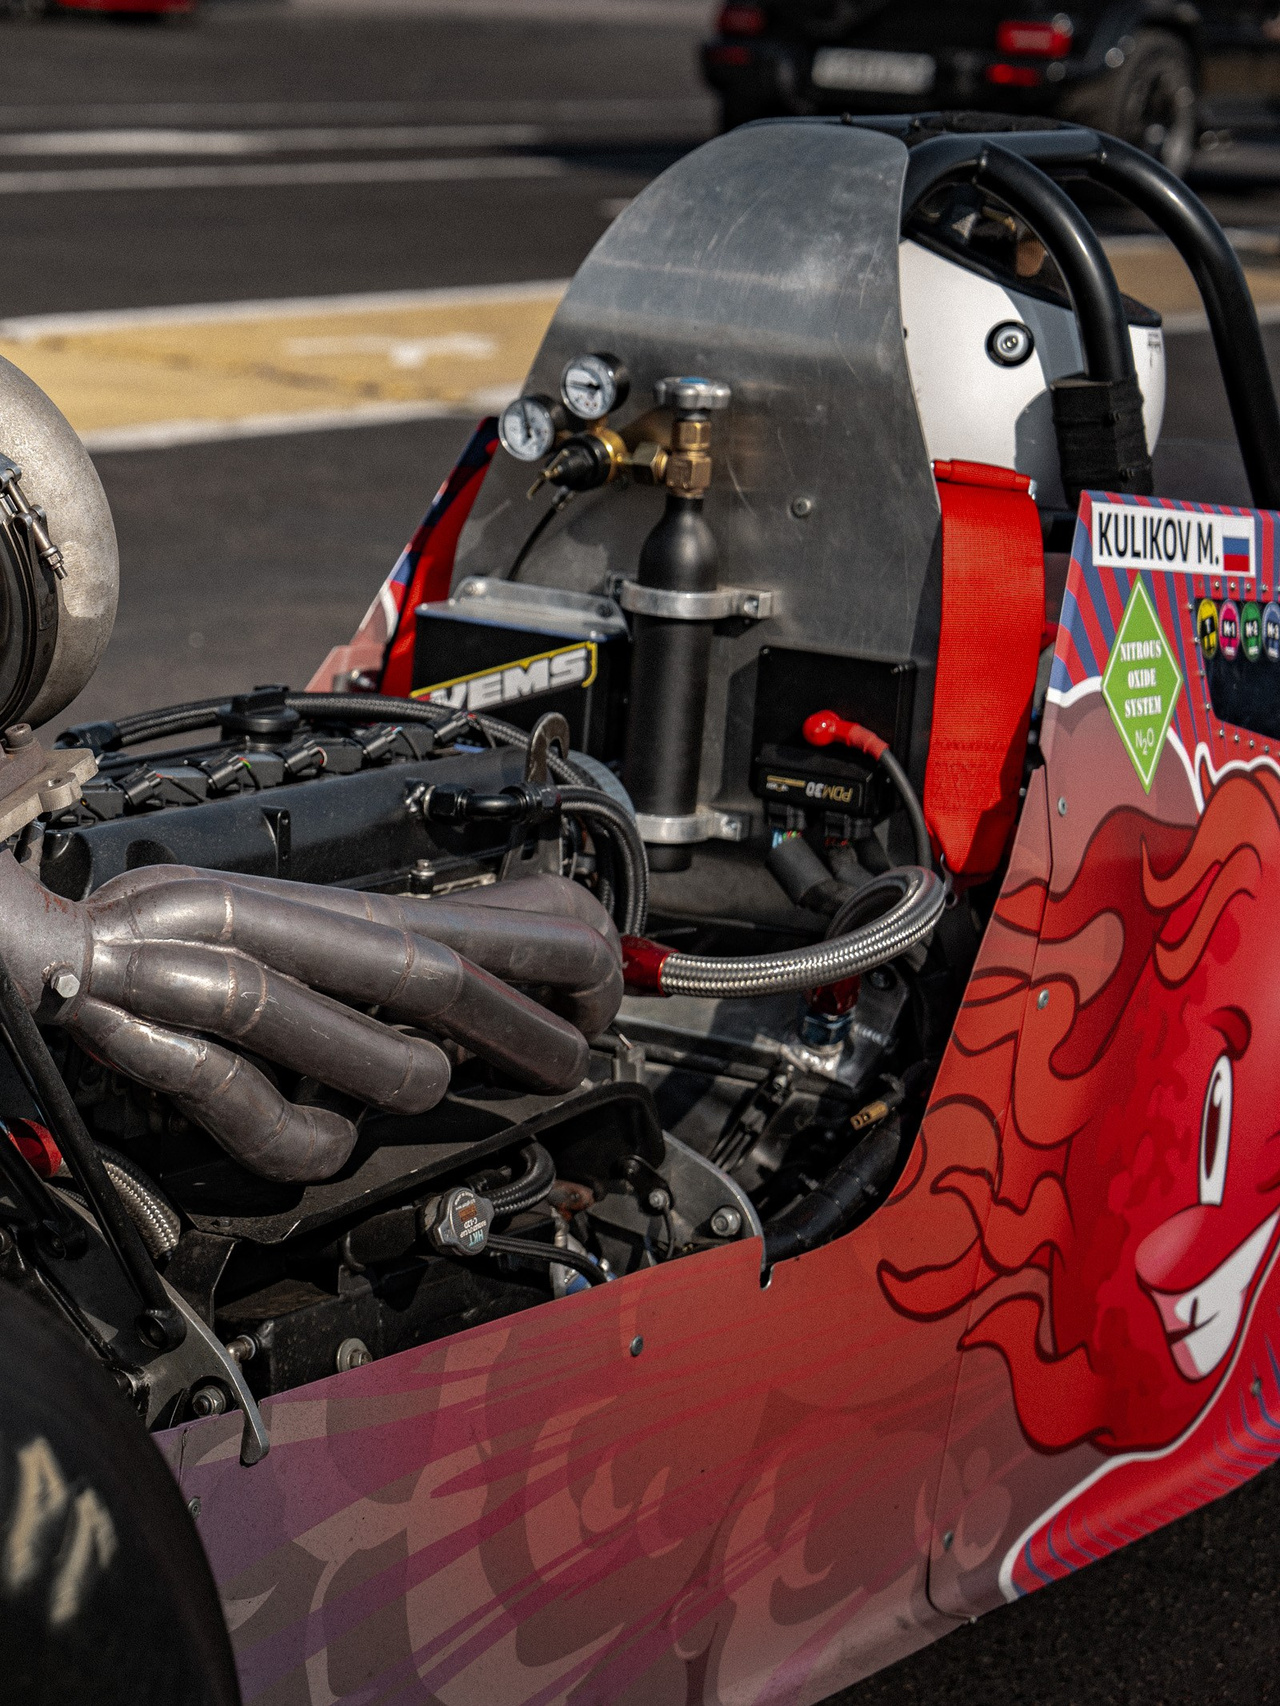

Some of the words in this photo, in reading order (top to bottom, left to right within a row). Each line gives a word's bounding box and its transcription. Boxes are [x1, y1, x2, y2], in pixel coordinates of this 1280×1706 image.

[1098, 512, 1191, 563] KULIKOV
[1197, 521, 1220, 566] M.
[1120, 640, 1162, 662] NITROUS
[430, 647, 587, 711] VEMS
[1127, 667, 1157, 690] OXIDE
[1124, 695, 1162, 718] SYSTEM
[805, 781, 853, 803] PDM30
